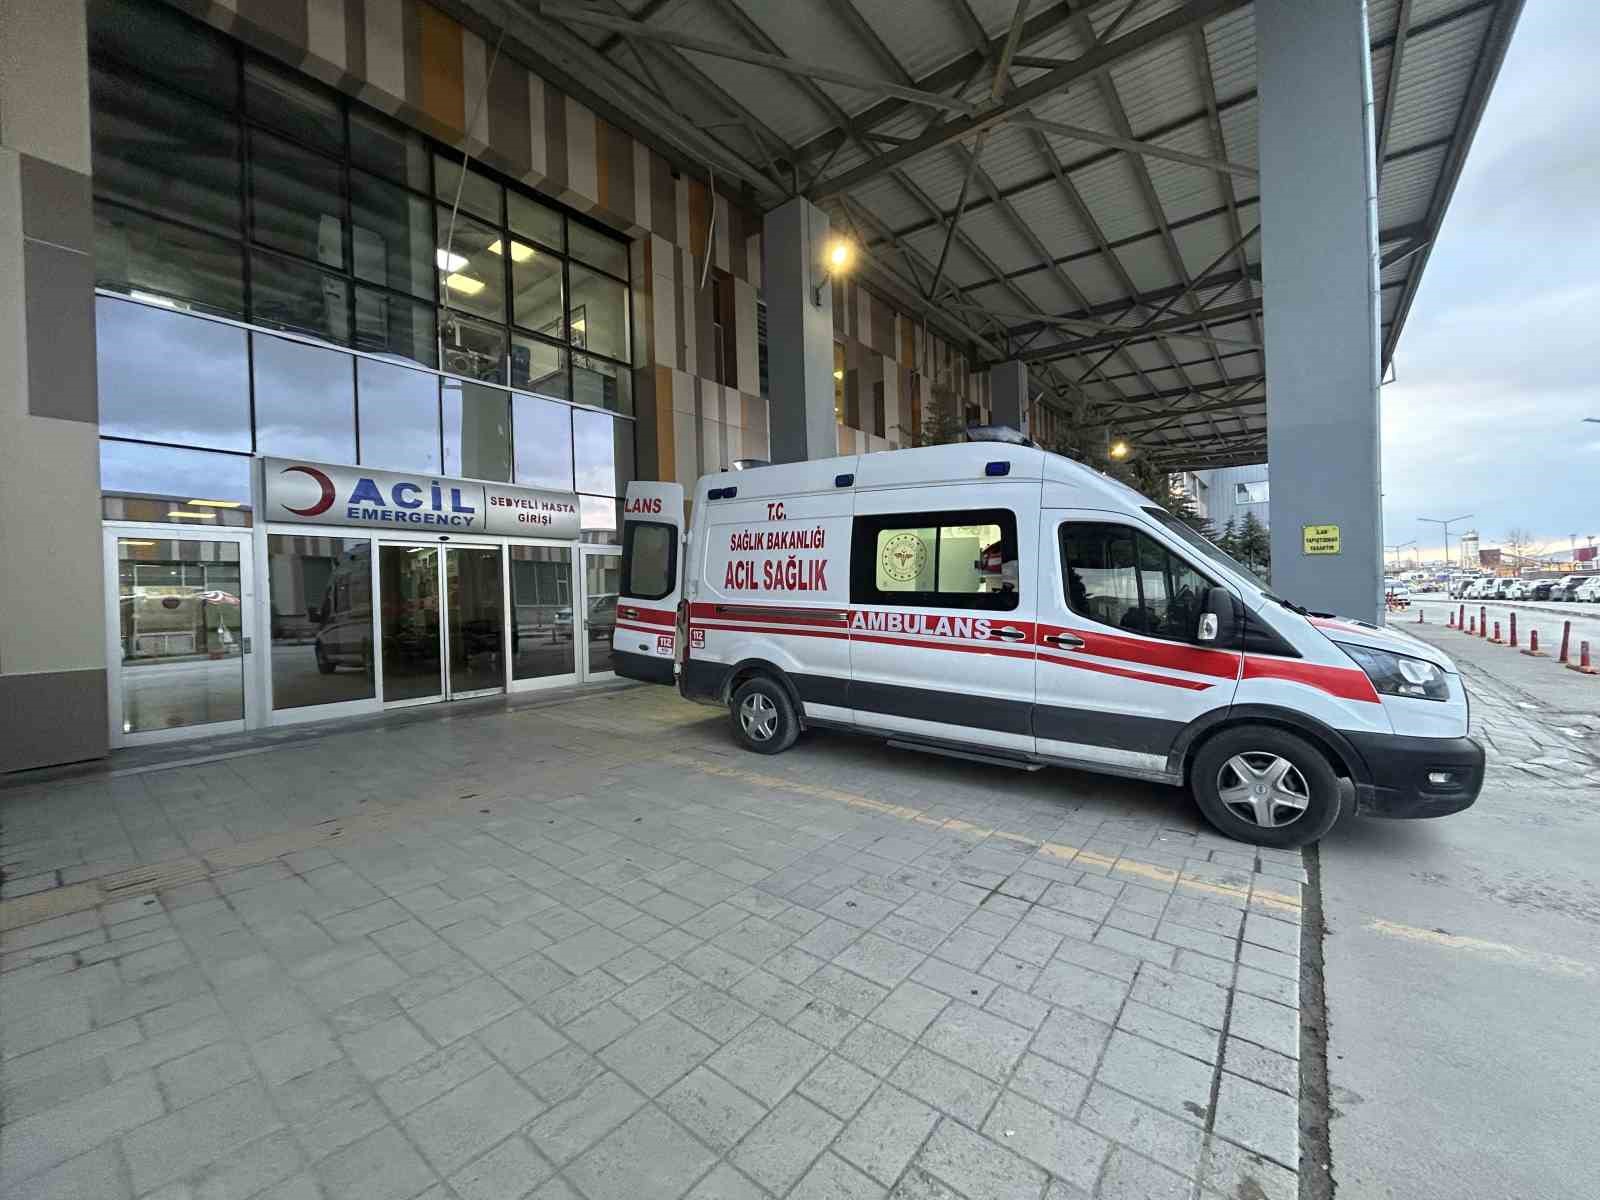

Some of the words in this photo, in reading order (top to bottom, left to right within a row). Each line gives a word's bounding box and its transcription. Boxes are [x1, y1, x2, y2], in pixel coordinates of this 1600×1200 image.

[347, 478, 476, 514] ACİL
[347, 506, 475, 528] EMERGENCY
[541, 501, 576, 513] HASTA
[767, 502, 787, 521] T.C.
[518, 512, 552, 526] GİRİŞİ
[730, 529, 764, 552] SAĞLIK
[767, 526, 825, 550] BAKANLIĞI
[763, 555, 828, 592] SAĞLIK
[693, 630, 703, 640] 112
[852, 610, 992, 640] AMBULANS
[660, 637, 672, 647] 112
